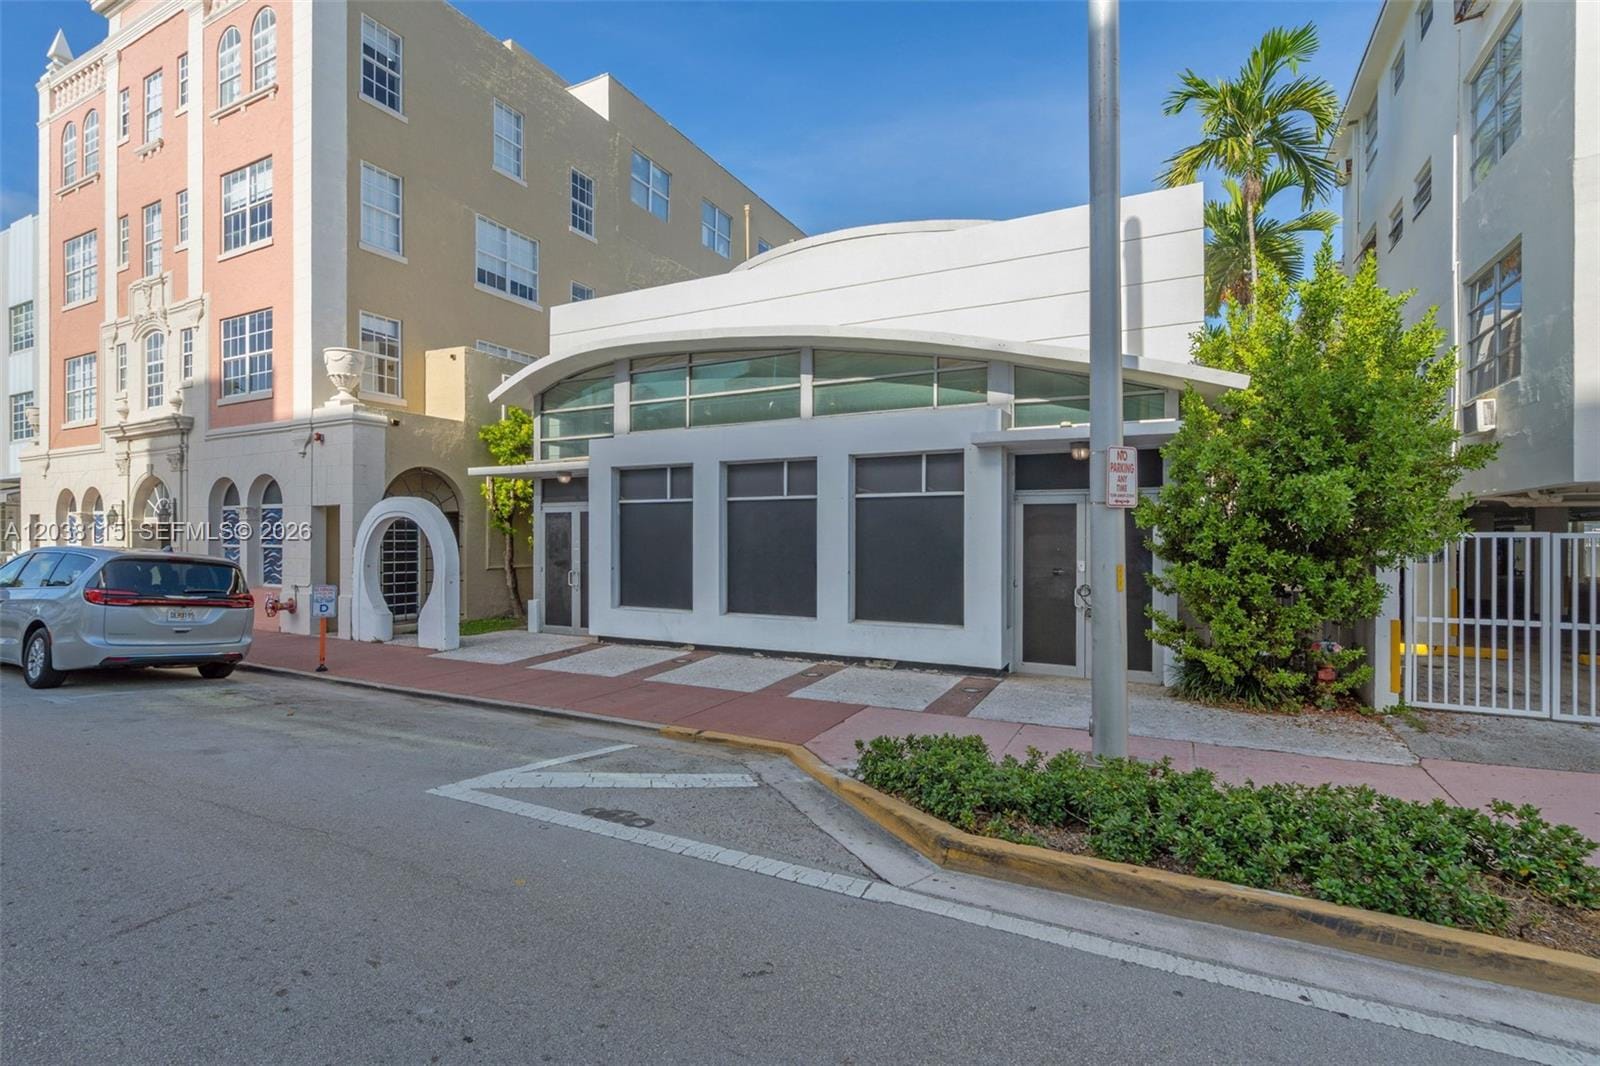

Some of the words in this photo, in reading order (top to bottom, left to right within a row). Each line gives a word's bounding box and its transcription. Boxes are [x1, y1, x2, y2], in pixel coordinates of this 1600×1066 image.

[1116, 450, 1128, 462] NO
[1110, 462, 1135, 474] PARKING
[1117, 475, 1128, 483] ANY
[319, 604, 329, 613] D
